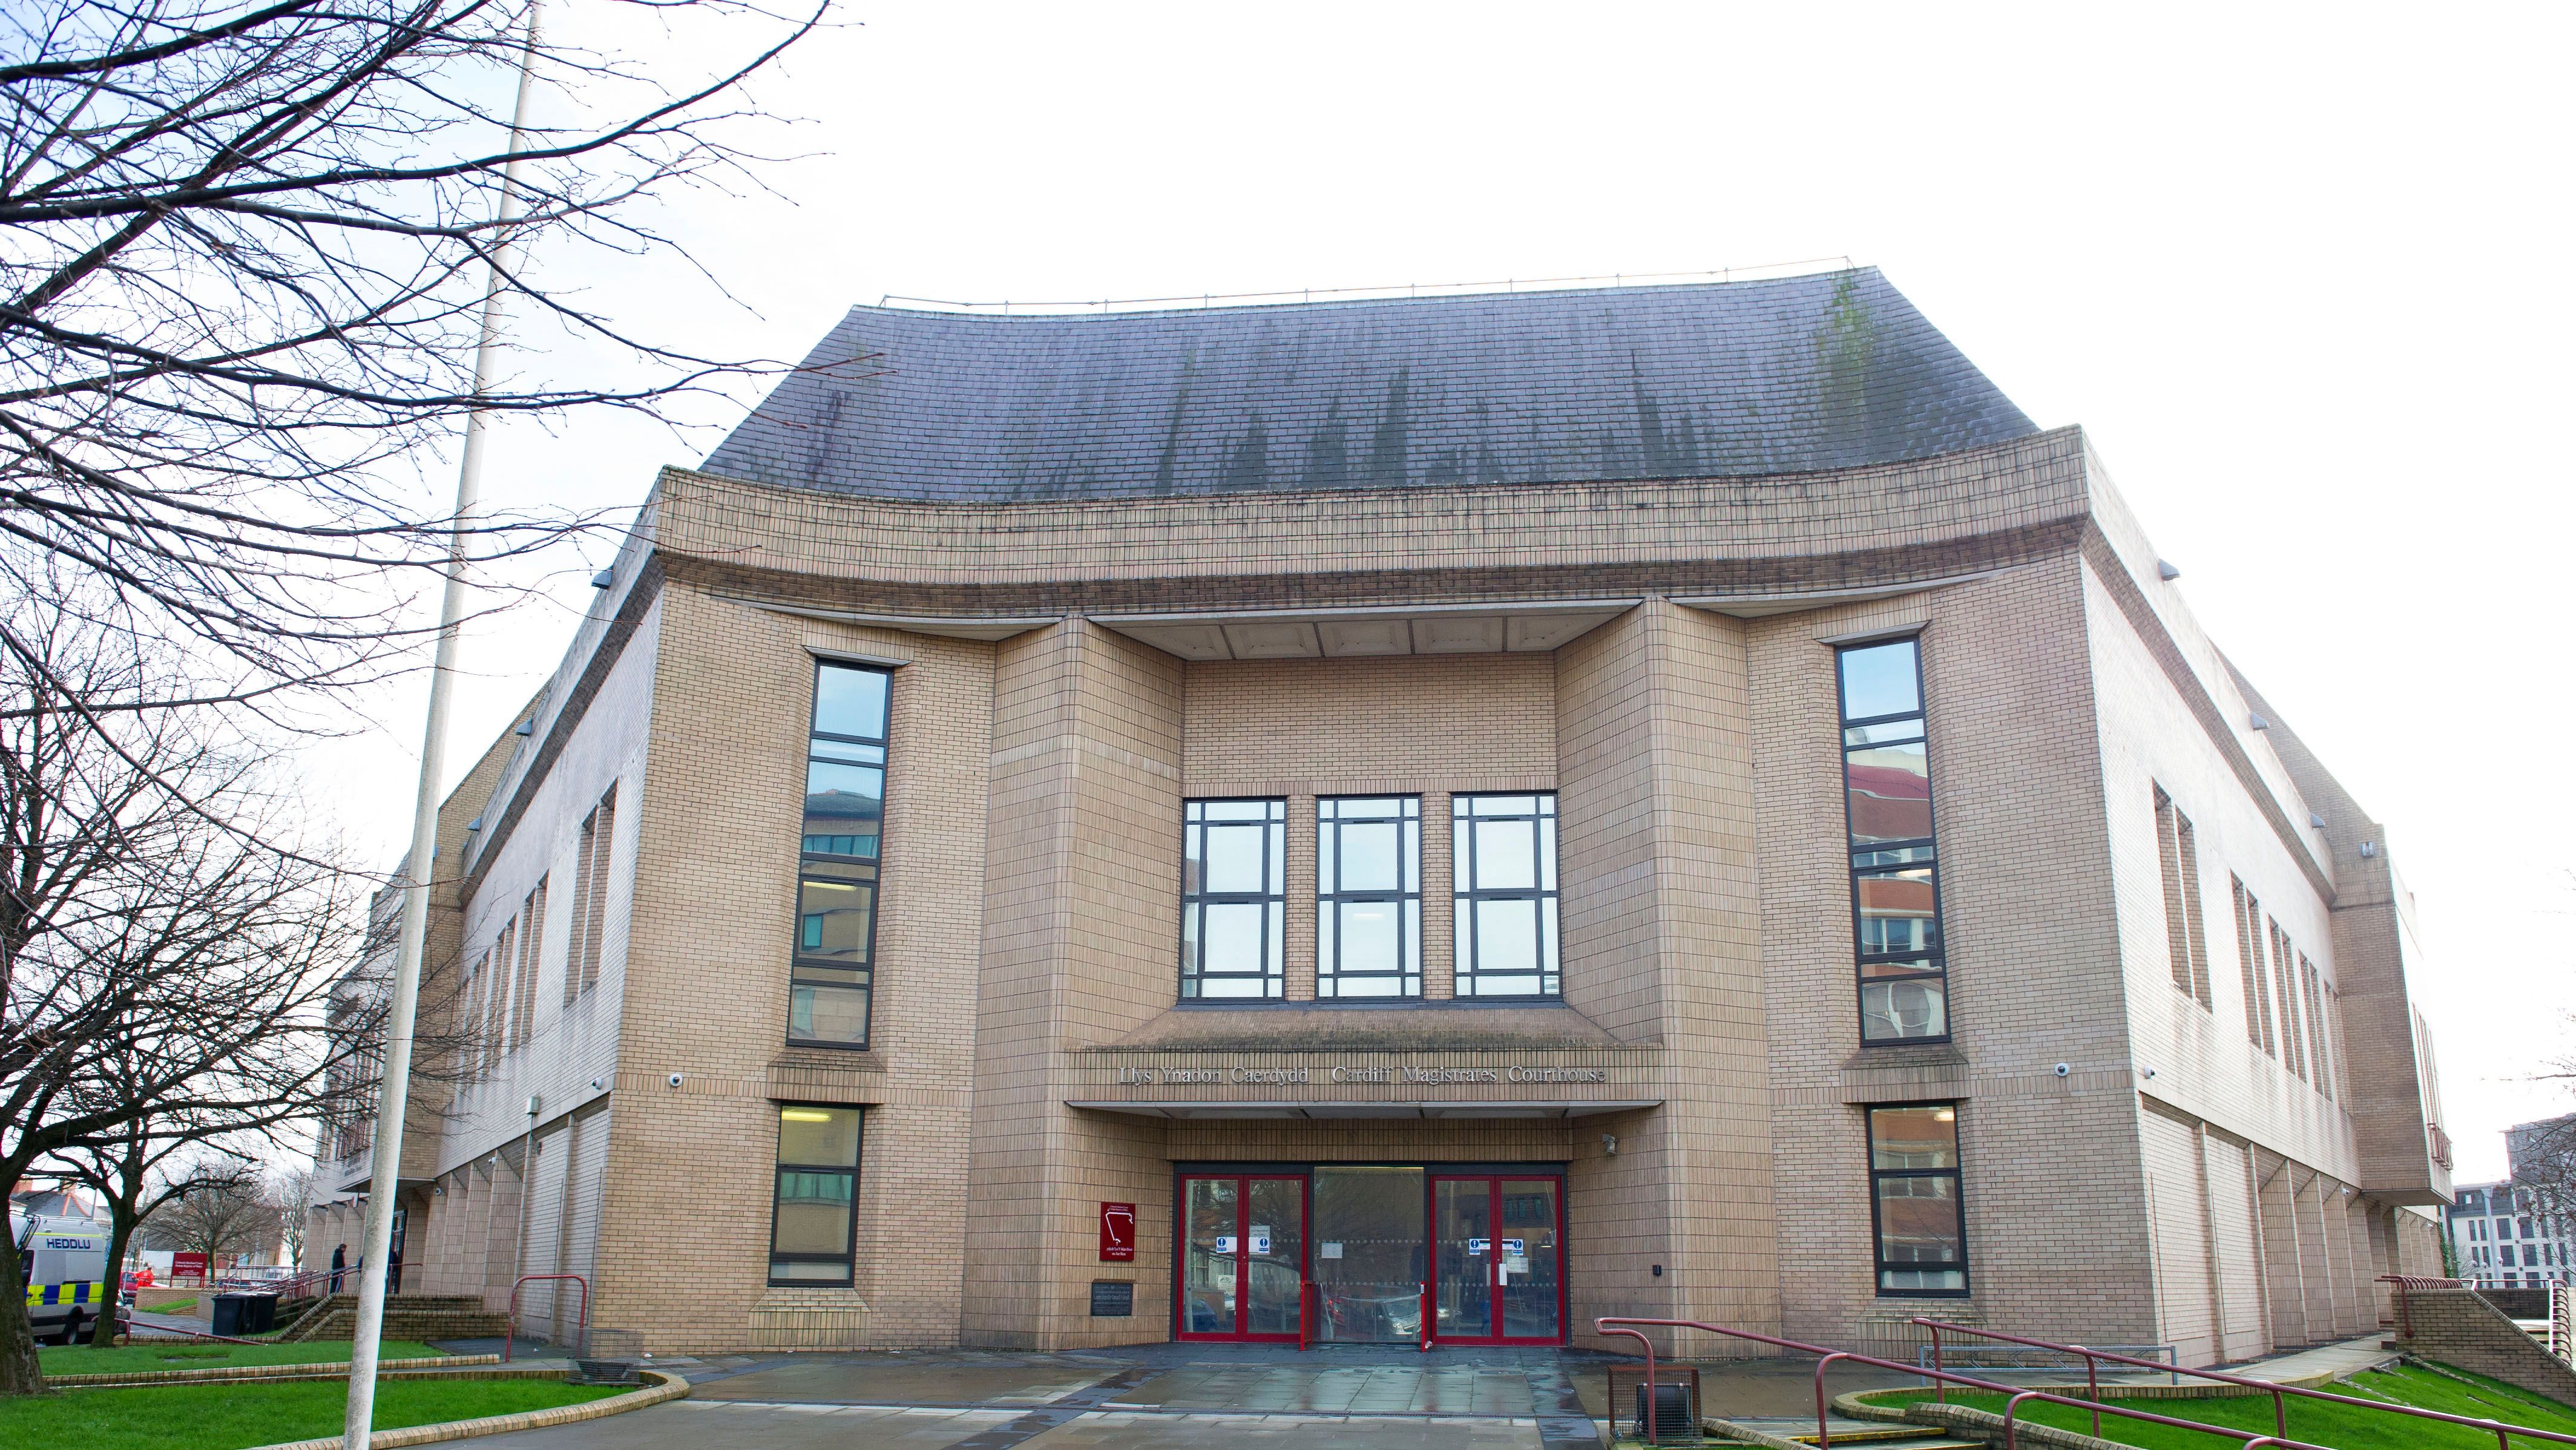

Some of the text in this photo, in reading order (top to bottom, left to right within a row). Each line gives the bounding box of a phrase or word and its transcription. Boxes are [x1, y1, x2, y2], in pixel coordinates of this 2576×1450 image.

[1118, 1066, 1606, 1086] Llys Ynadon Caerdydd Cardiff Magistrates Courthouse
[47, 1238, 91, 1249] HEDDLU
